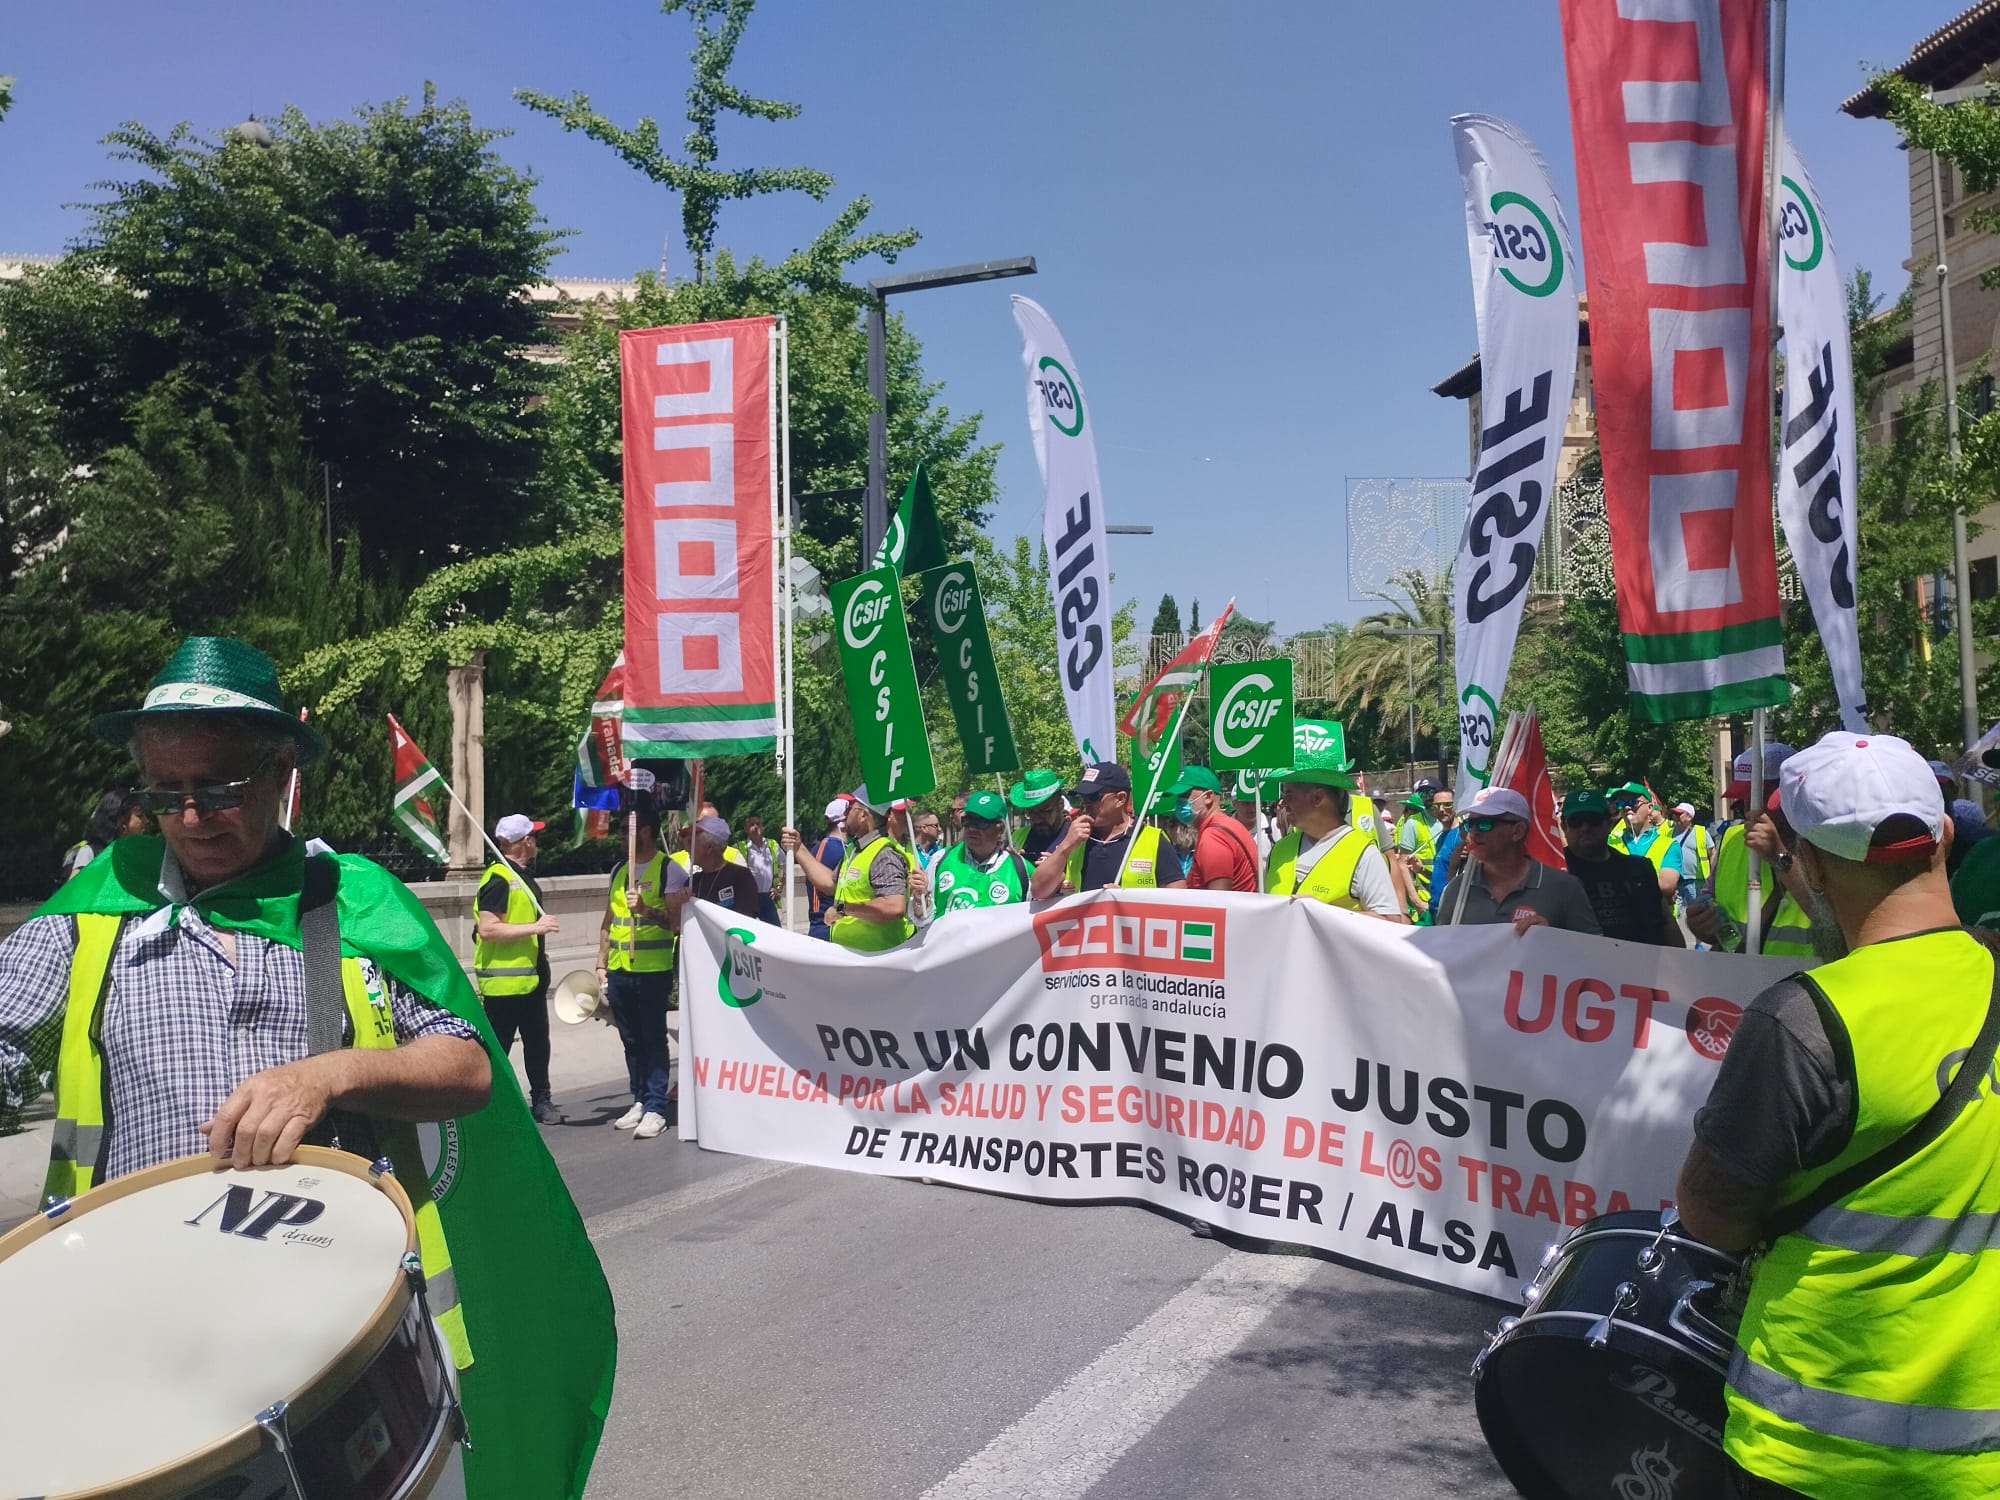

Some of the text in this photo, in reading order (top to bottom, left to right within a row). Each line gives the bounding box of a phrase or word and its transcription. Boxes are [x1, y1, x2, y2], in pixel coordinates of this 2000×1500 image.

[852, 594, 892, 628] CSIF
[942, 588, 972, 614] CSIF
[869, 650, 905, 793] CSIF
[960, 638, 995, 766] CSIF
[1226, 698, 1283, 730] CSIF
[1045, 915, 1177, 959] CCOO
[733, 950, 763, 982] CSIF
[1044, 970, 1226, 1000] servicios a la ciudadanía
[1090, 993, 1226, 1019] granada andalucía
[1503, 970, 1669, 1050] UGT
[816, 1022, 1587, 1164] POR UN CONVENIO JUSTO
[717, 1059, 829, 1106] HUELGA
[838, 1073, 887, 1112] POR
[893, 1080, 931, 1115] LA
[938, 1082, 1027, 1121] SALUD
[1036, 1084, 1053, 1121] Y
[1060, 1084, 1265, 1152] SEGURIDAD
[1282, 1116, 1345, 1167] DE
[1360, 1130, 1443, 1191] L@S
[1458, 1156, 1676, 1228] TRABA
[184, 1183, 326, 1241] NP
[844, 1125, 1520, 1279] DE TRANSPORTES ROBER / ALSA
[282, 1228, 334, 1249] drums
[1607, 1363, 1724, 1446] Pear
